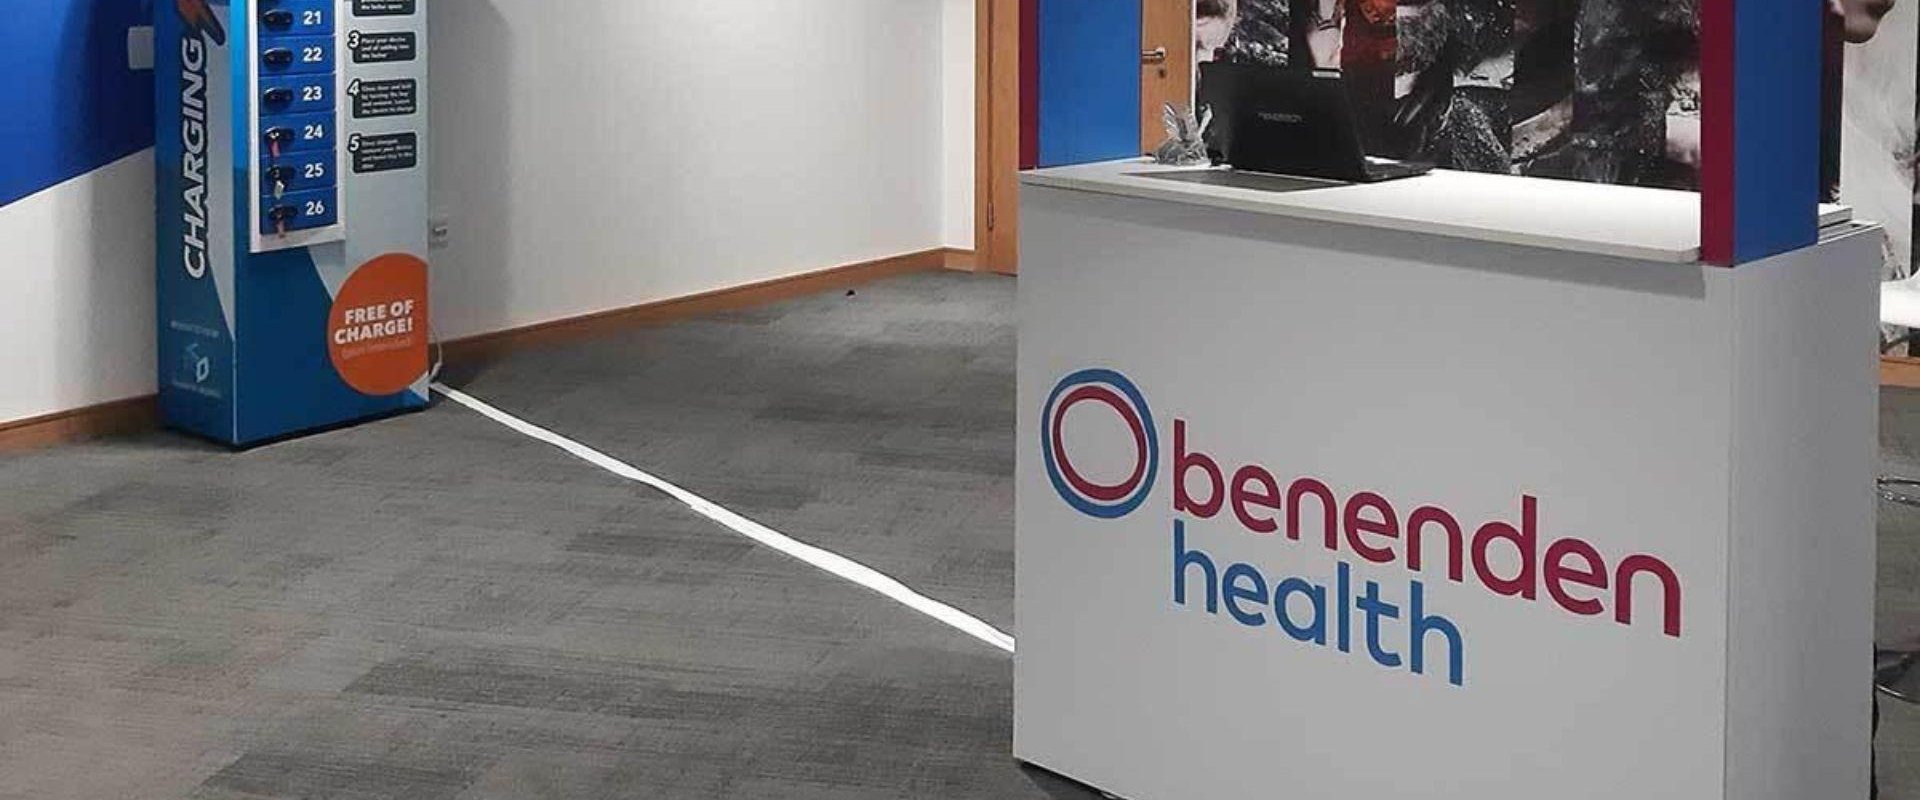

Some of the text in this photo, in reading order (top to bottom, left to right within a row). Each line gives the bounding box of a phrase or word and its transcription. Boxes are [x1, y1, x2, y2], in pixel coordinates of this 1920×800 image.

[303, 10, 321, 25] 21
[349, 31, 359, 48] 3
[303, 46, 322, 62] 22
[303, 85, 322, 101] 23
[349, 80, 360, 96] 4
[304, 124, 323, 140] 24
[349, 135, 360, 152] 5
[182, 37, 206, 280] CHARGING
[304, 162, 324, 178] 25
[306, 201, 325, 216] 26
[344, 299, 415, 325] FREE OF
[334, 316, 414, 345] CHARGE!
[1173, 418, 1681, 638] benenden
[1173, 518, 1463, 686] health
